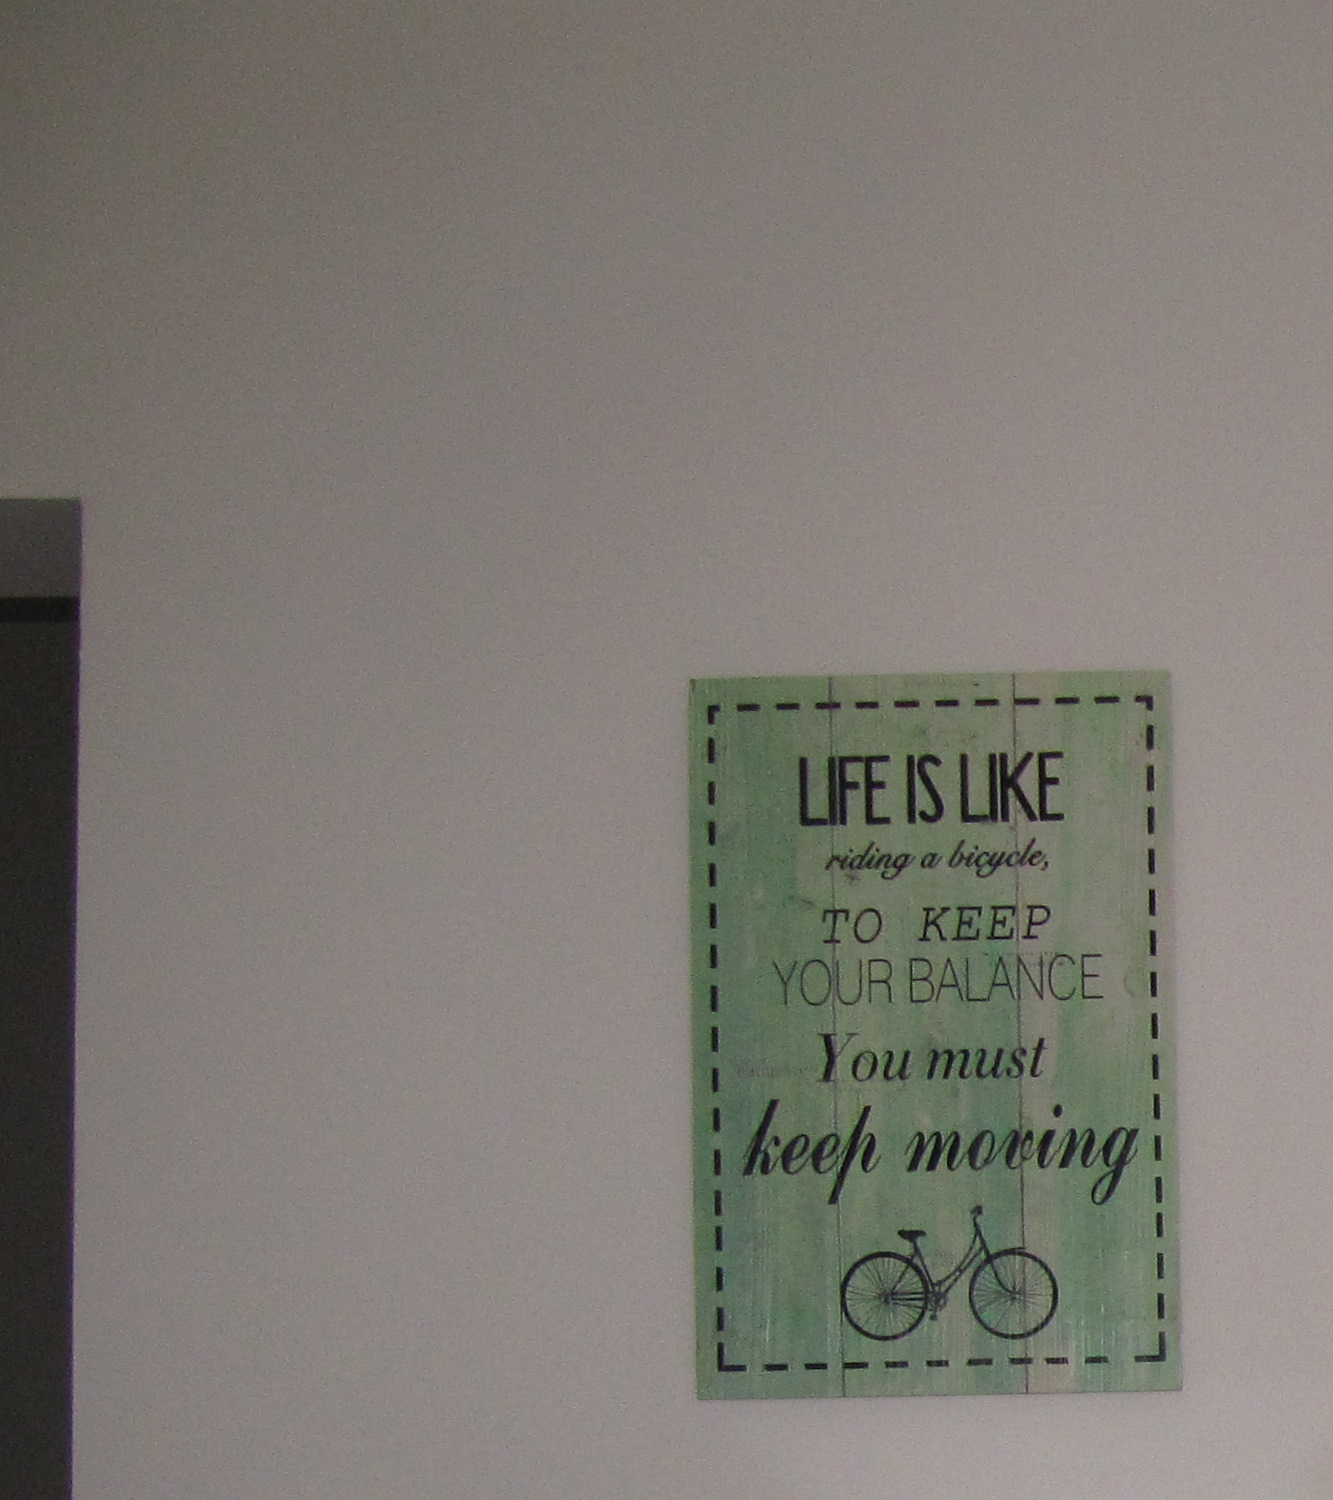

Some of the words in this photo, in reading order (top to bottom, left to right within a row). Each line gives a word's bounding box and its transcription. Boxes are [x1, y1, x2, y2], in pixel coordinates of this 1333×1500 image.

[798, 755, 891, 826] LIFE
[907, 753, 944, 824] IS
[960, 751, 1064, 823] LIKE
[825, 841, 912, 879] riding
[920, 851, 942, 869] a
[948, 839, 1049, 877] bicycle,
[822, 908, 883, 944] TO
[918, 905, 1053, 942] KEEP
[772, 958, 893, 1006] YOUR
[909, 954, 1104, 1003] BALANCE
[817, 1033, 911, 1083] You
[927, 1037, 1046, 1081] must
[742, 1099, 883, 1205] keep
[905, 1104, 1140, 1205] moving
